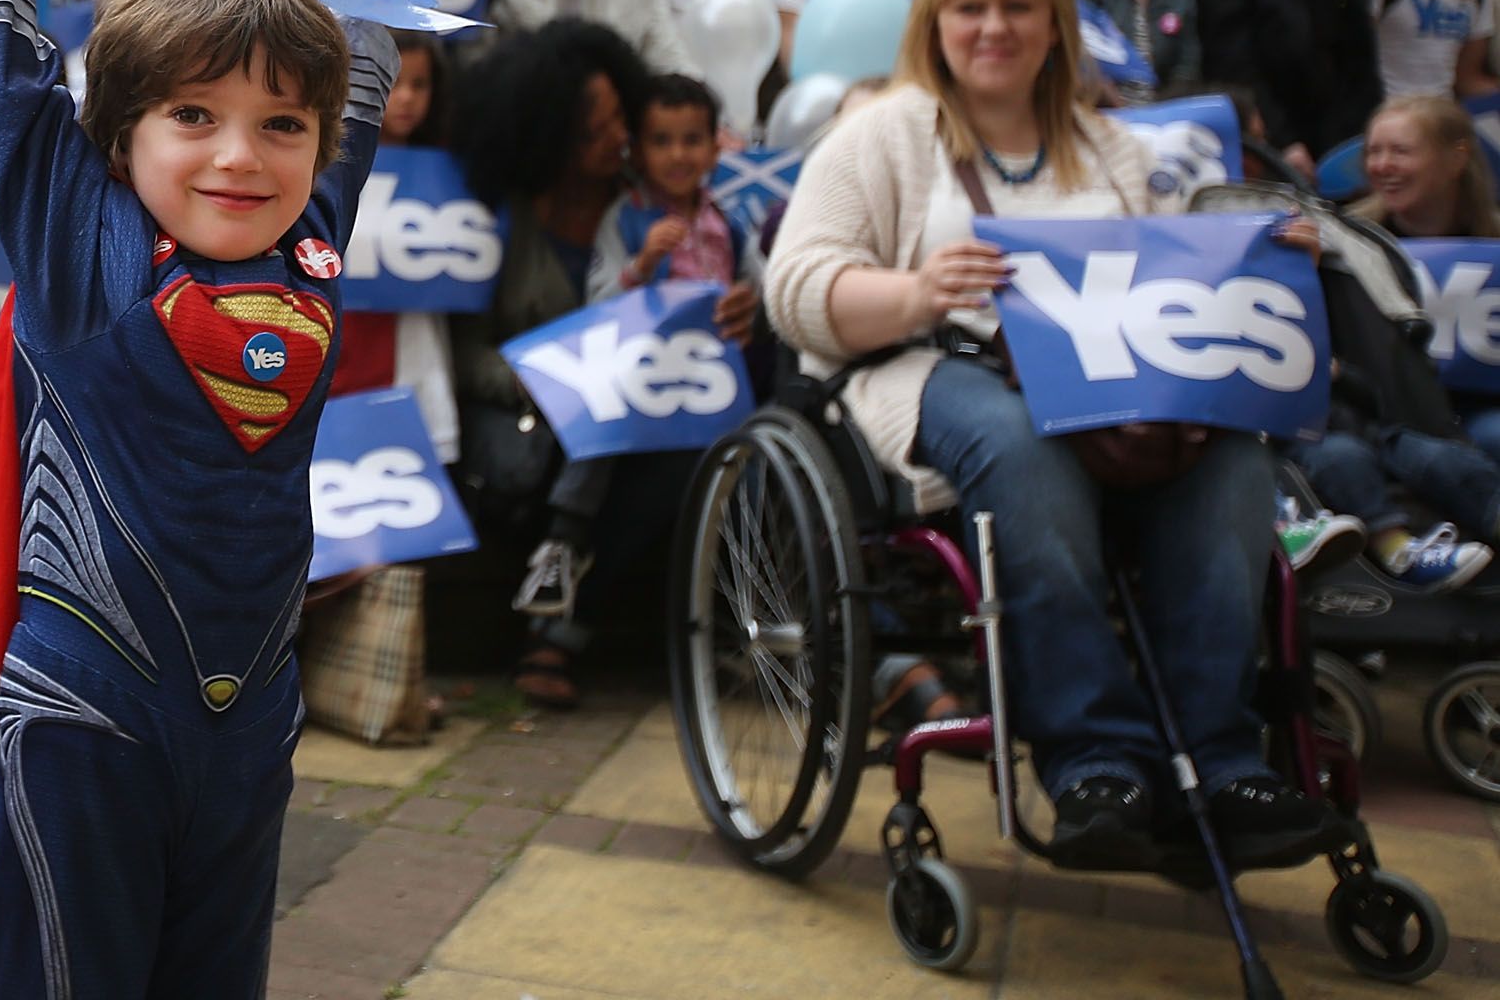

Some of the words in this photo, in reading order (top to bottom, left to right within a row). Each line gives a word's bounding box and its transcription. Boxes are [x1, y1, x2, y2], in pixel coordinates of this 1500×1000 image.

[248, 348, 285, 370] Yes
[1009, 251, 1315, 392] Yes
[518, 322, 738, 423] Yes
[310, 447, 442, 540] es
